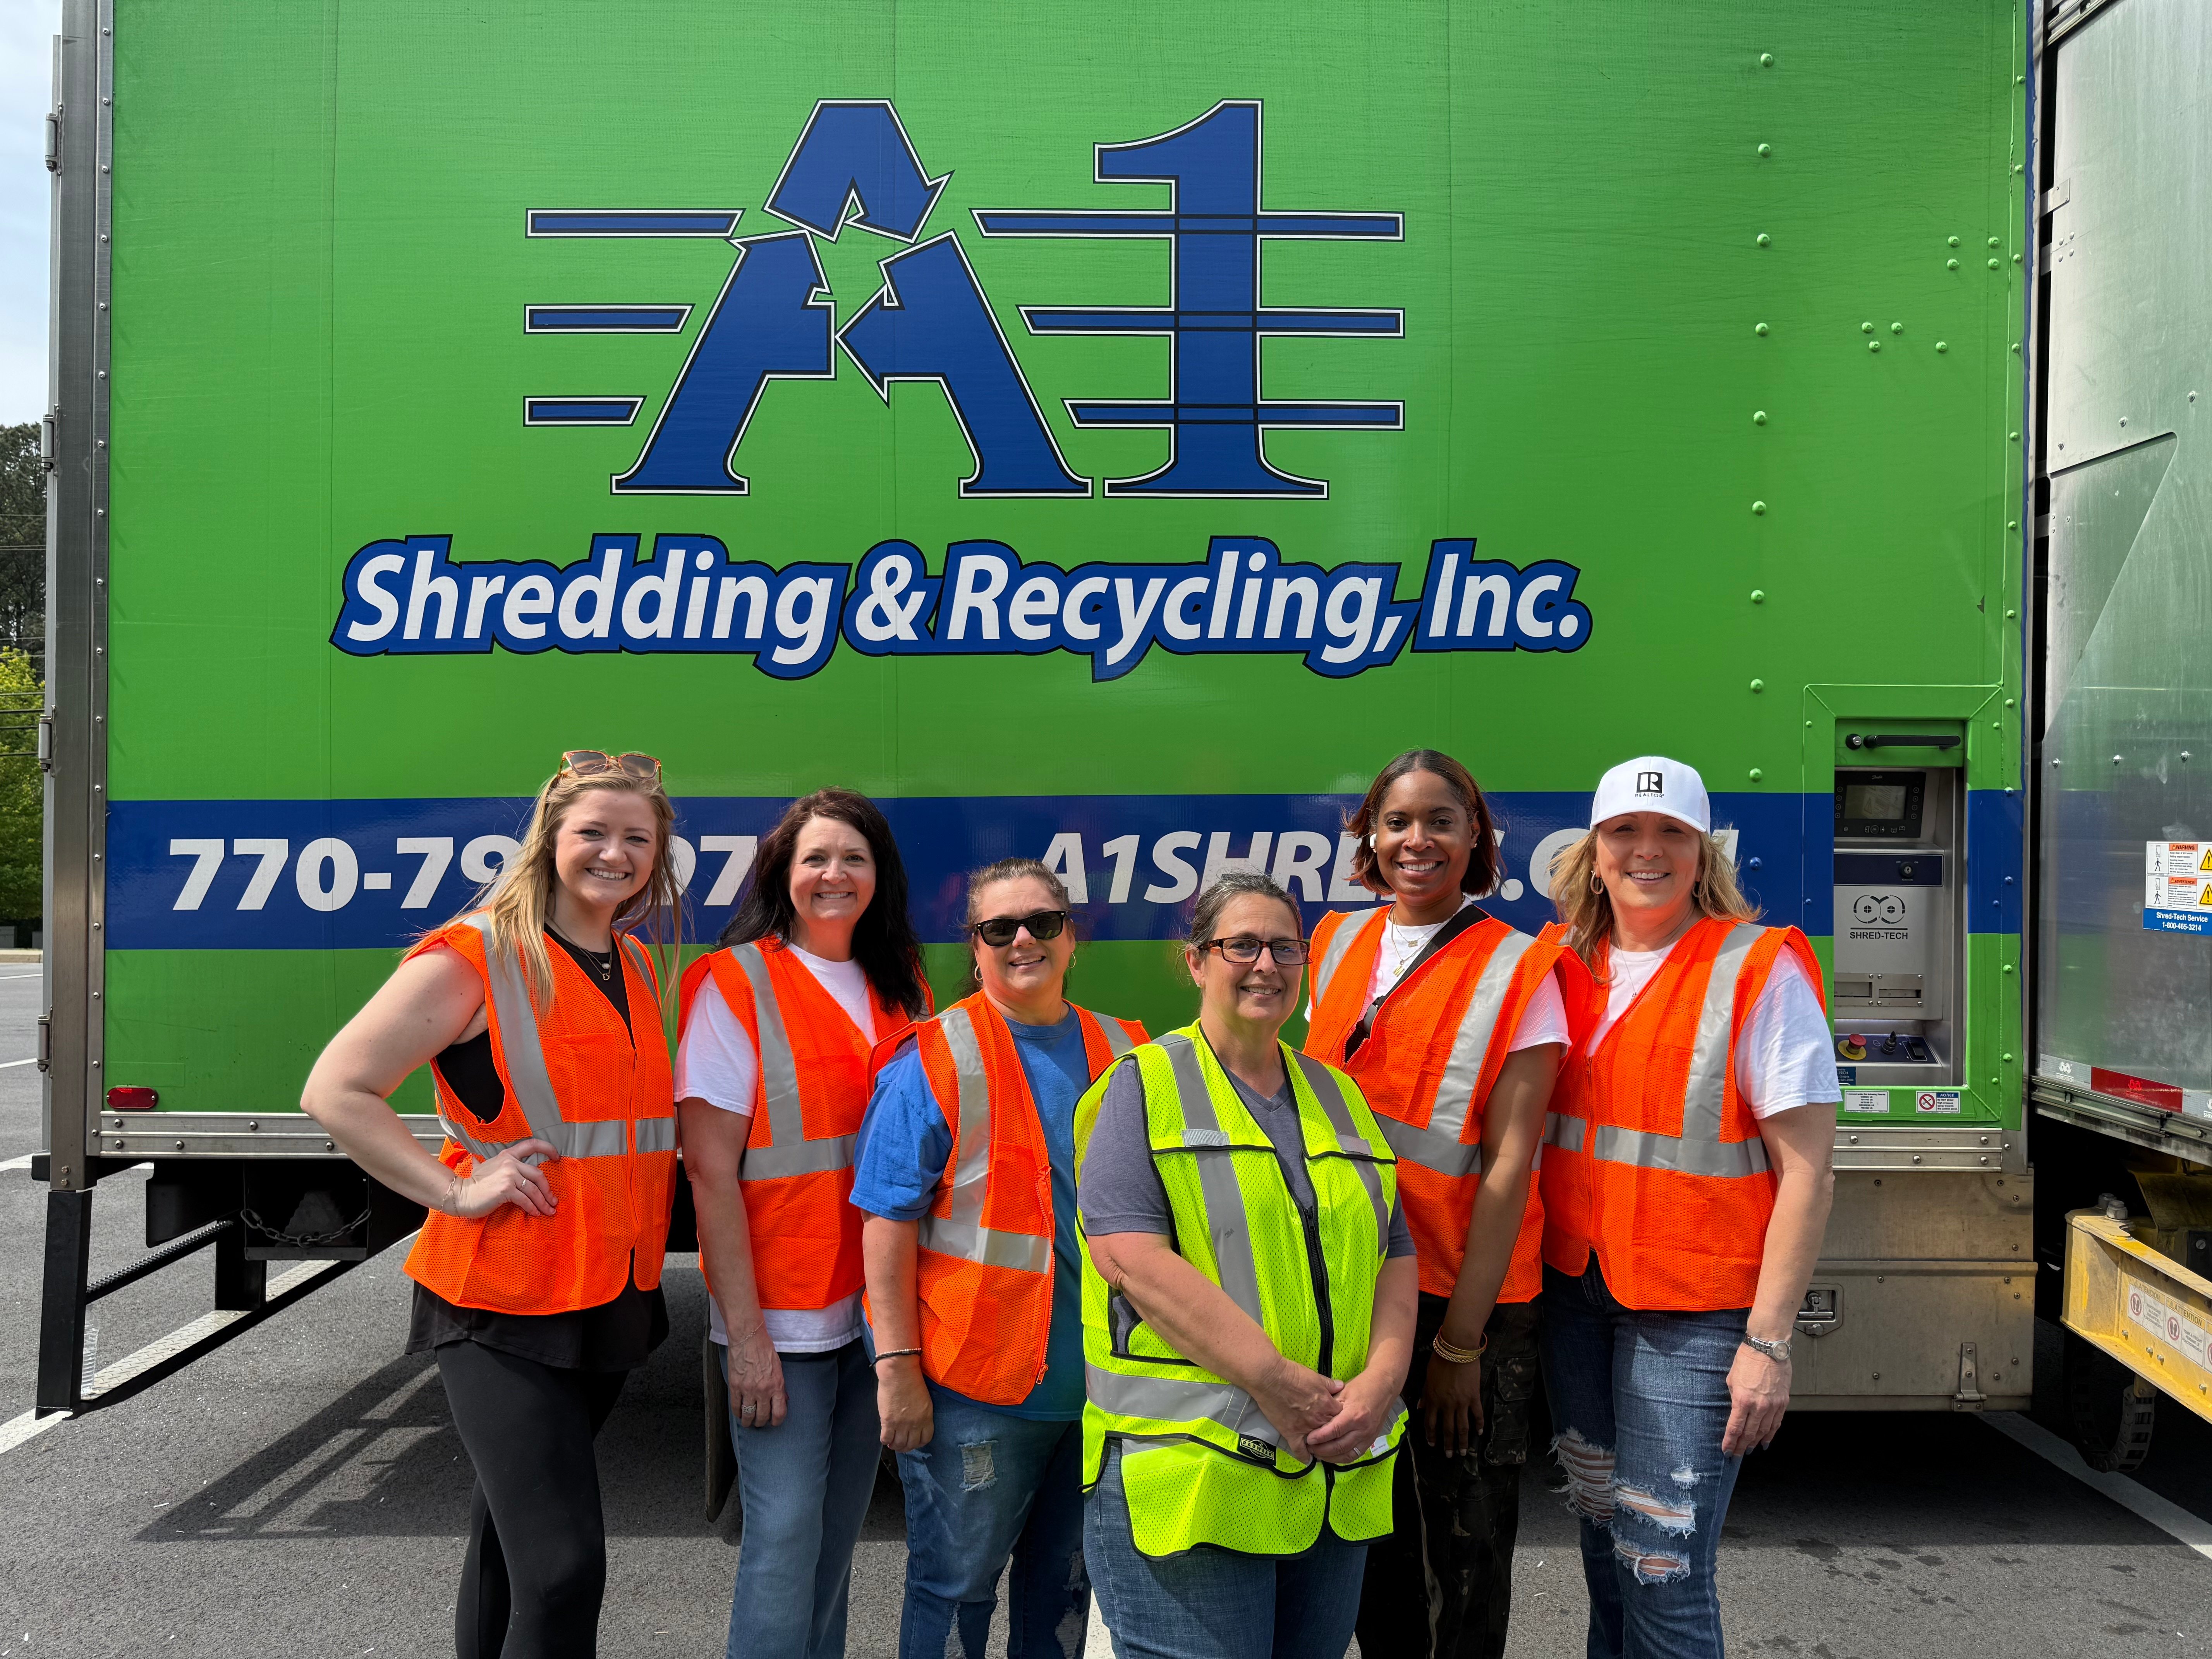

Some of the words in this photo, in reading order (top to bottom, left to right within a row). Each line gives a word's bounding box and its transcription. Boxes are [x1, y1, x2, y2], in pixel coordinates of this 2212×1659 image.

[611, 99, 1329, 499] A1
[347, 548, 834, 665] Shredding
[855, 555, 926, 641] &
[947, 551, 1403, 665] Recycling,
[1429, 553, 1578, 638] Inc.
[2156, 912, 2186, 921] Shred-Tech
[2188, 914, 2208, 922] Service
[2162, 921, 2202, 931] 1-800-465-3214
[1850, 931, 1908, 939] SHRED-TECH
[1224, 1228, 1235, 1238] 3M
[2174, 1305, 2202, 1327] ATTENTION
[1243, 1441, 1273, 1456] RADWEAR
